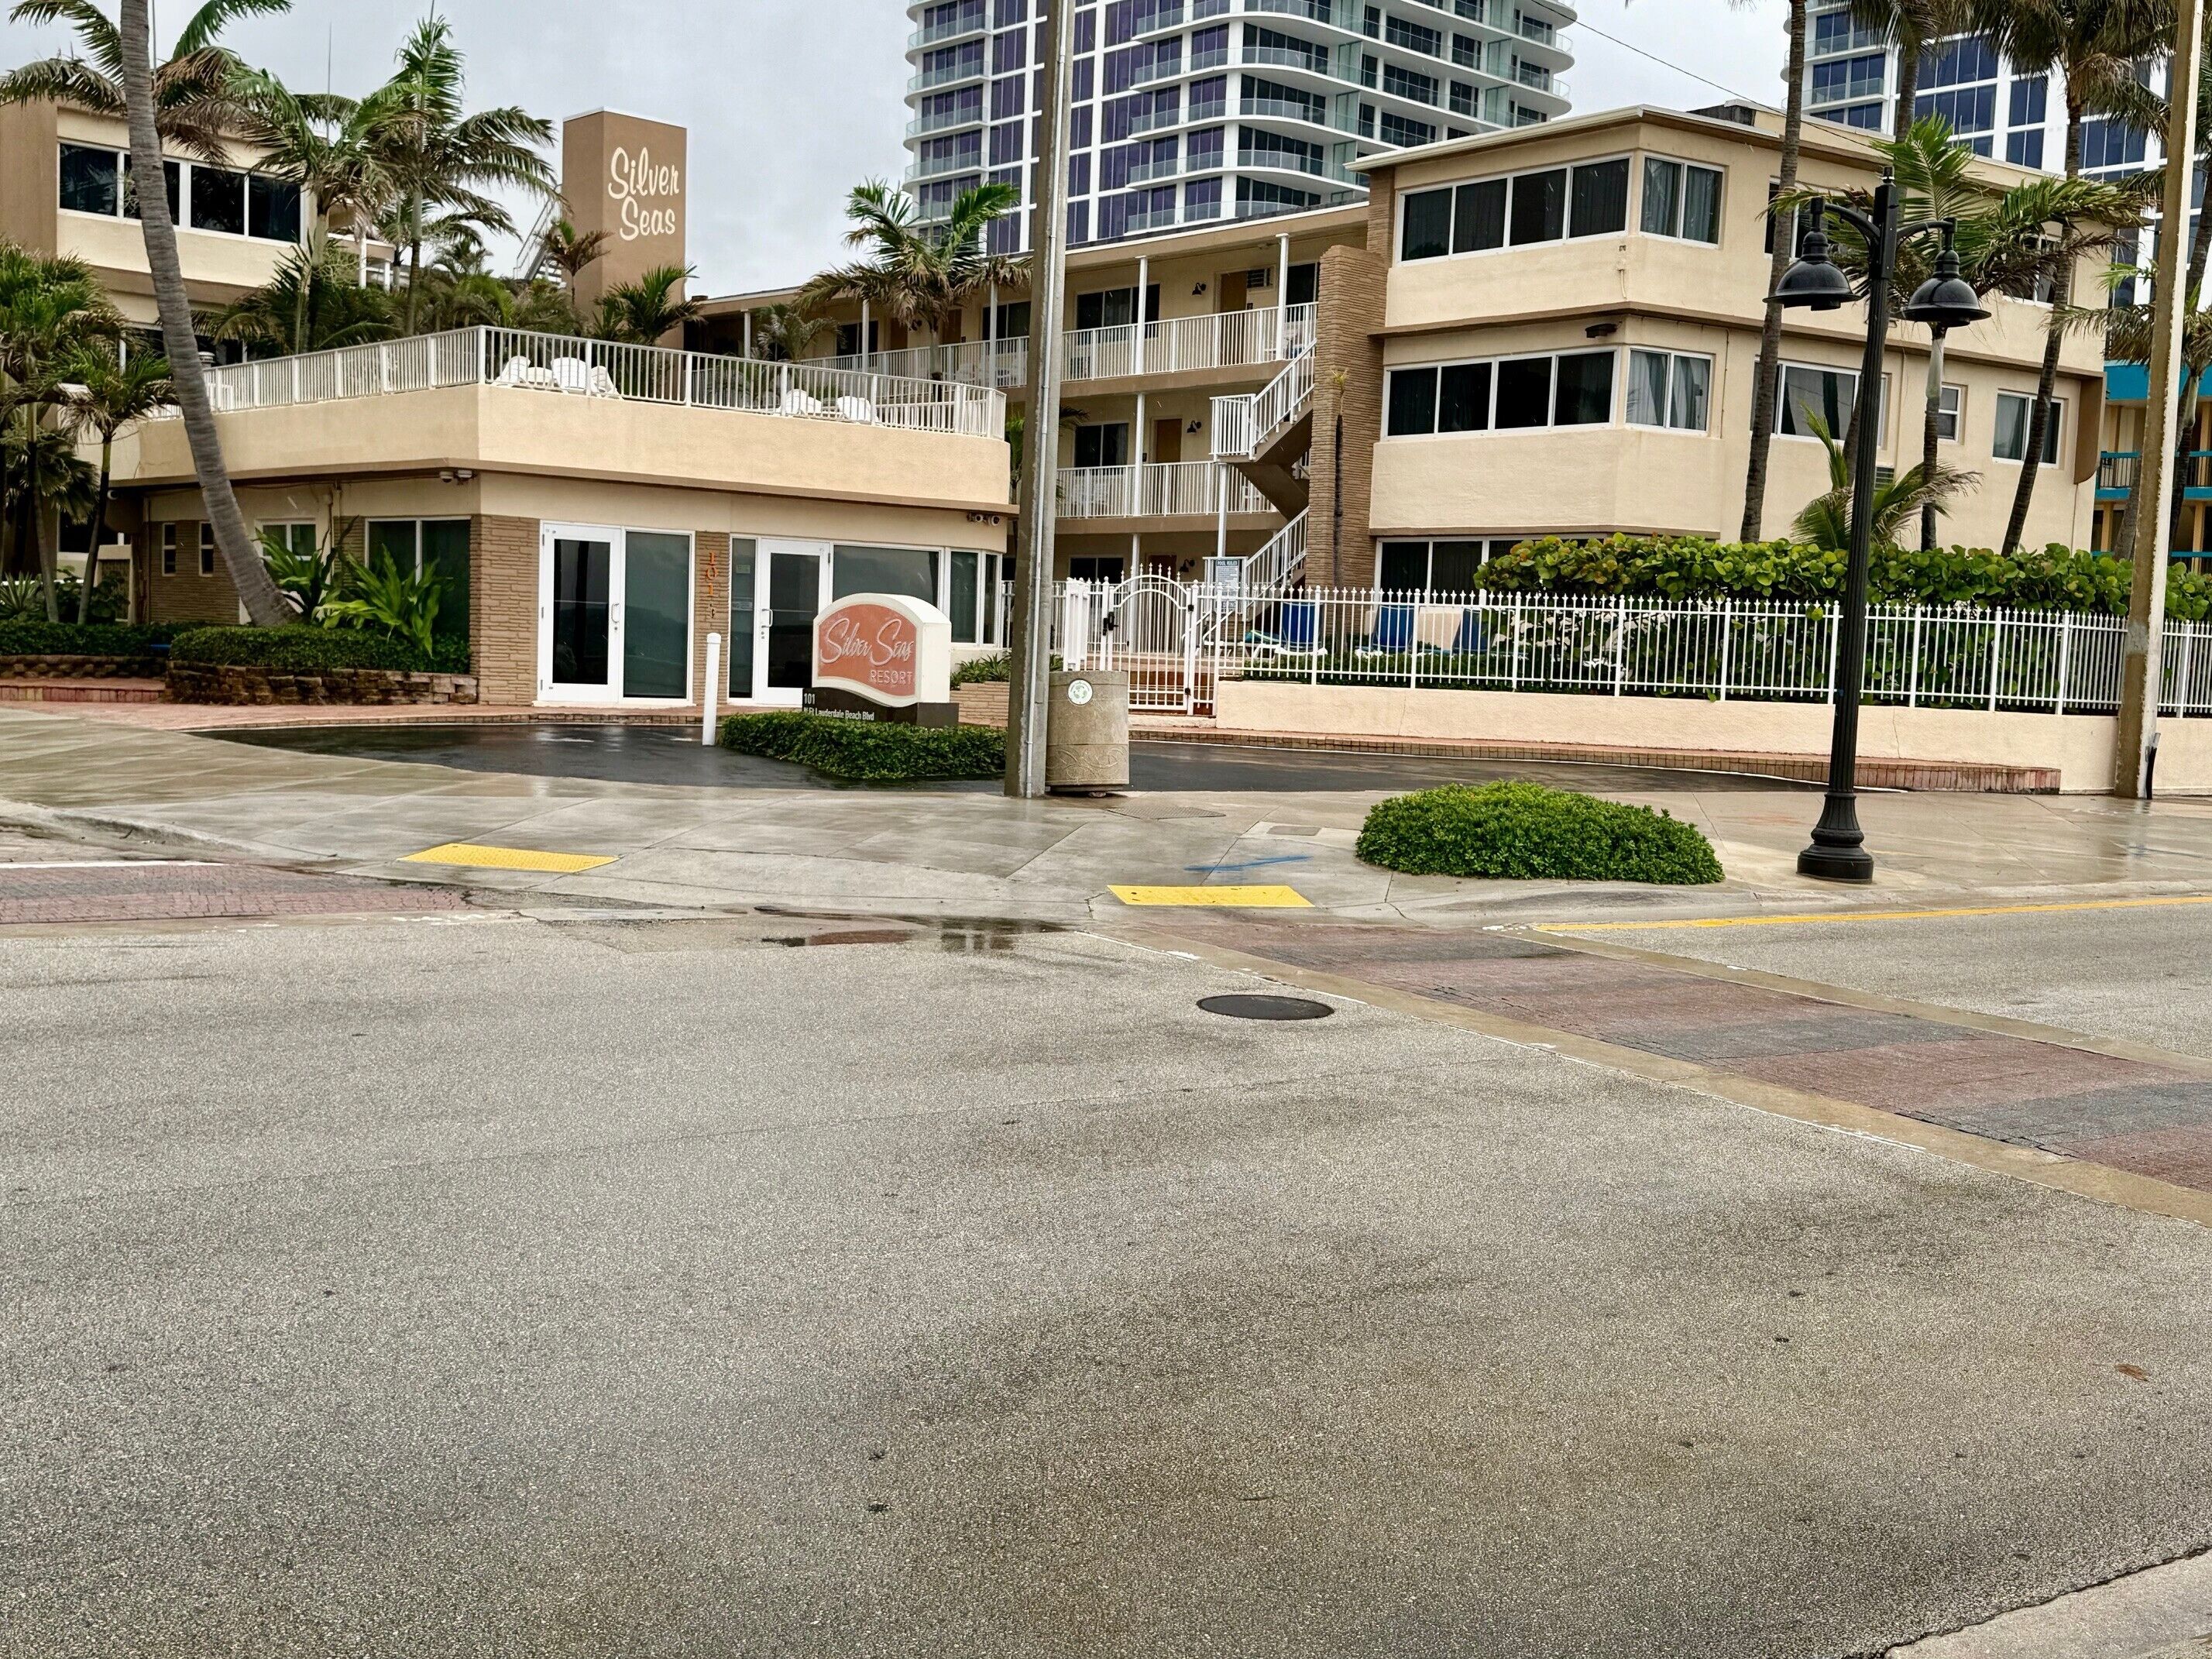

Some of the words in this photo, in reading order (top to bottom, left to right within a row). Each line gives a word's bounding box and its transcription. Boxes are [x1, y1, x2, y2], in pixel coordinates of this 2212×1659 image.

[608, 146, 680, 199] Silver
[620, 196, 675, 241] Seas
[706, 551, 719, 597] 101
[819, 618, 871, 664] Silver
[869, 619, 914, 666] Seas
[803, 692, 816, 705] 101
[868, 669, 913, 685] RESORT
[815, 707, 844, 718] Lauderdale
[844, 709, 861, 720] Beach
[862, 711, 875, 721] Blvd
